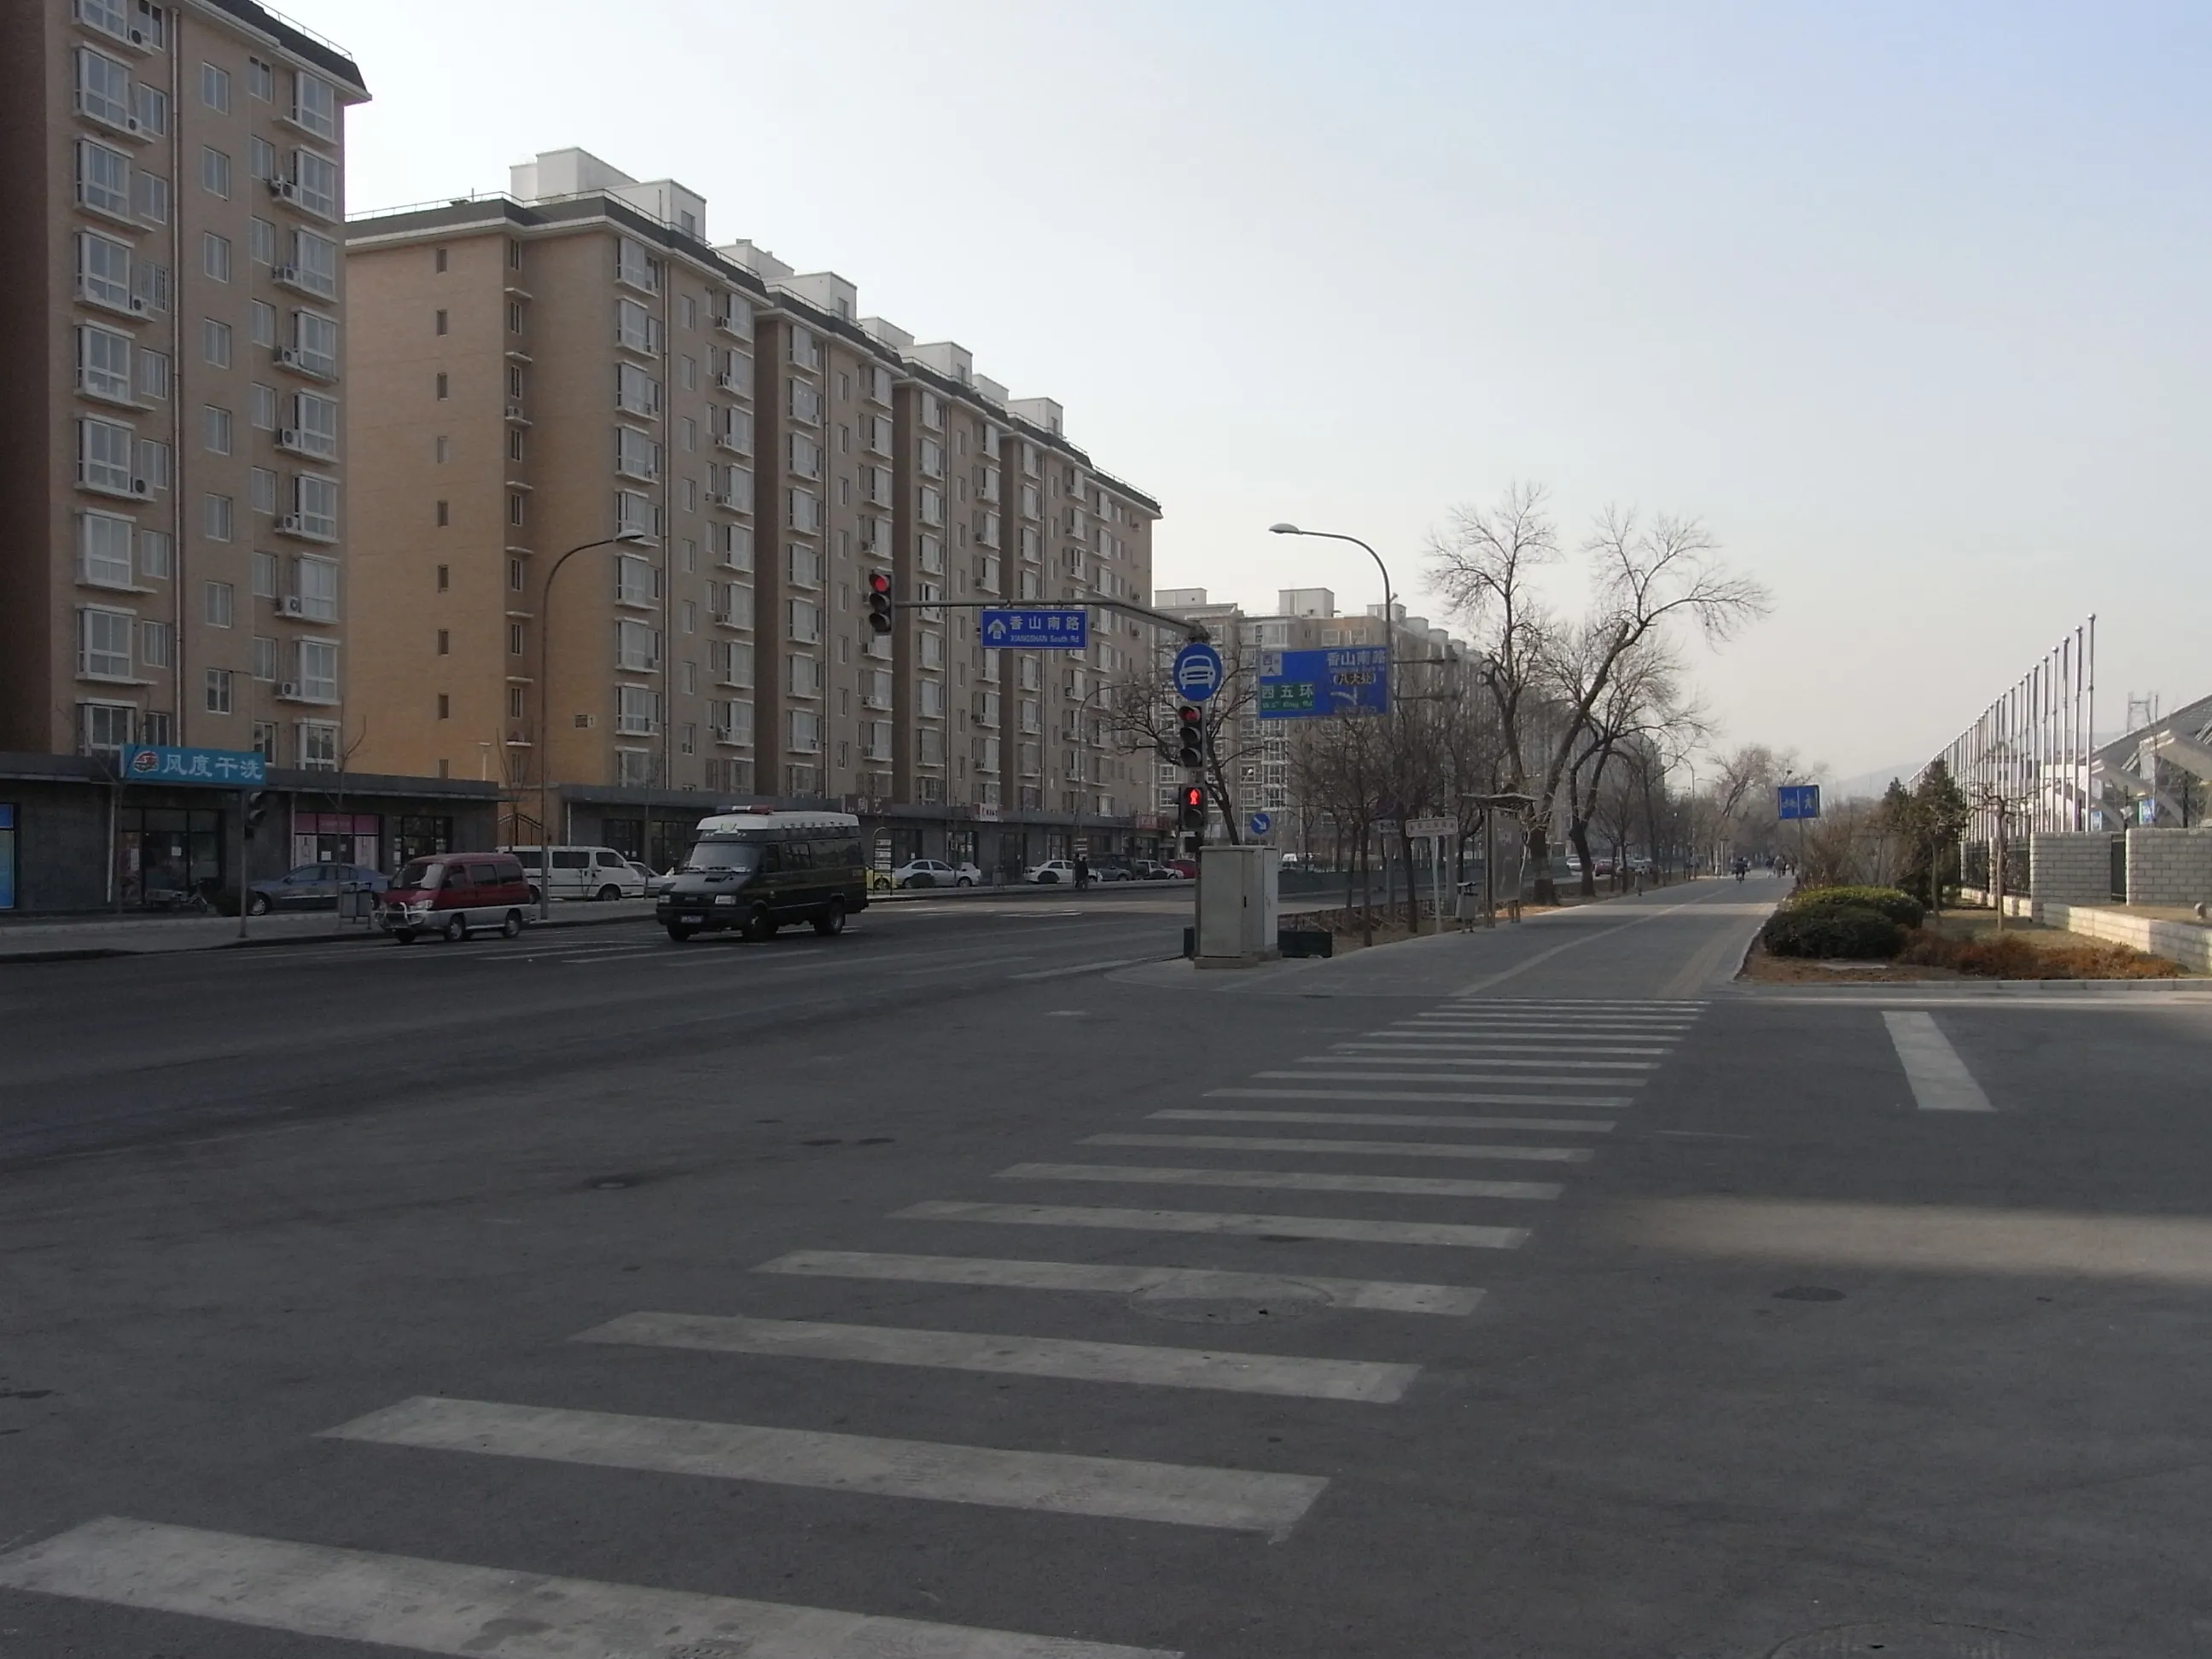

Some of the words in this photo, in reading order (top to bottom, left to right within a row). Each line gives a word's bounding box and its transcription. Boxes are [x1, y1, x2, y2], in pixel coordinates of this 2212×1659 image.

[1010, 615, 1080, 631] 香山南路
[1261, 684, 1313, 699] 西五环
[161, 754, 263, 780] 风度干洗
